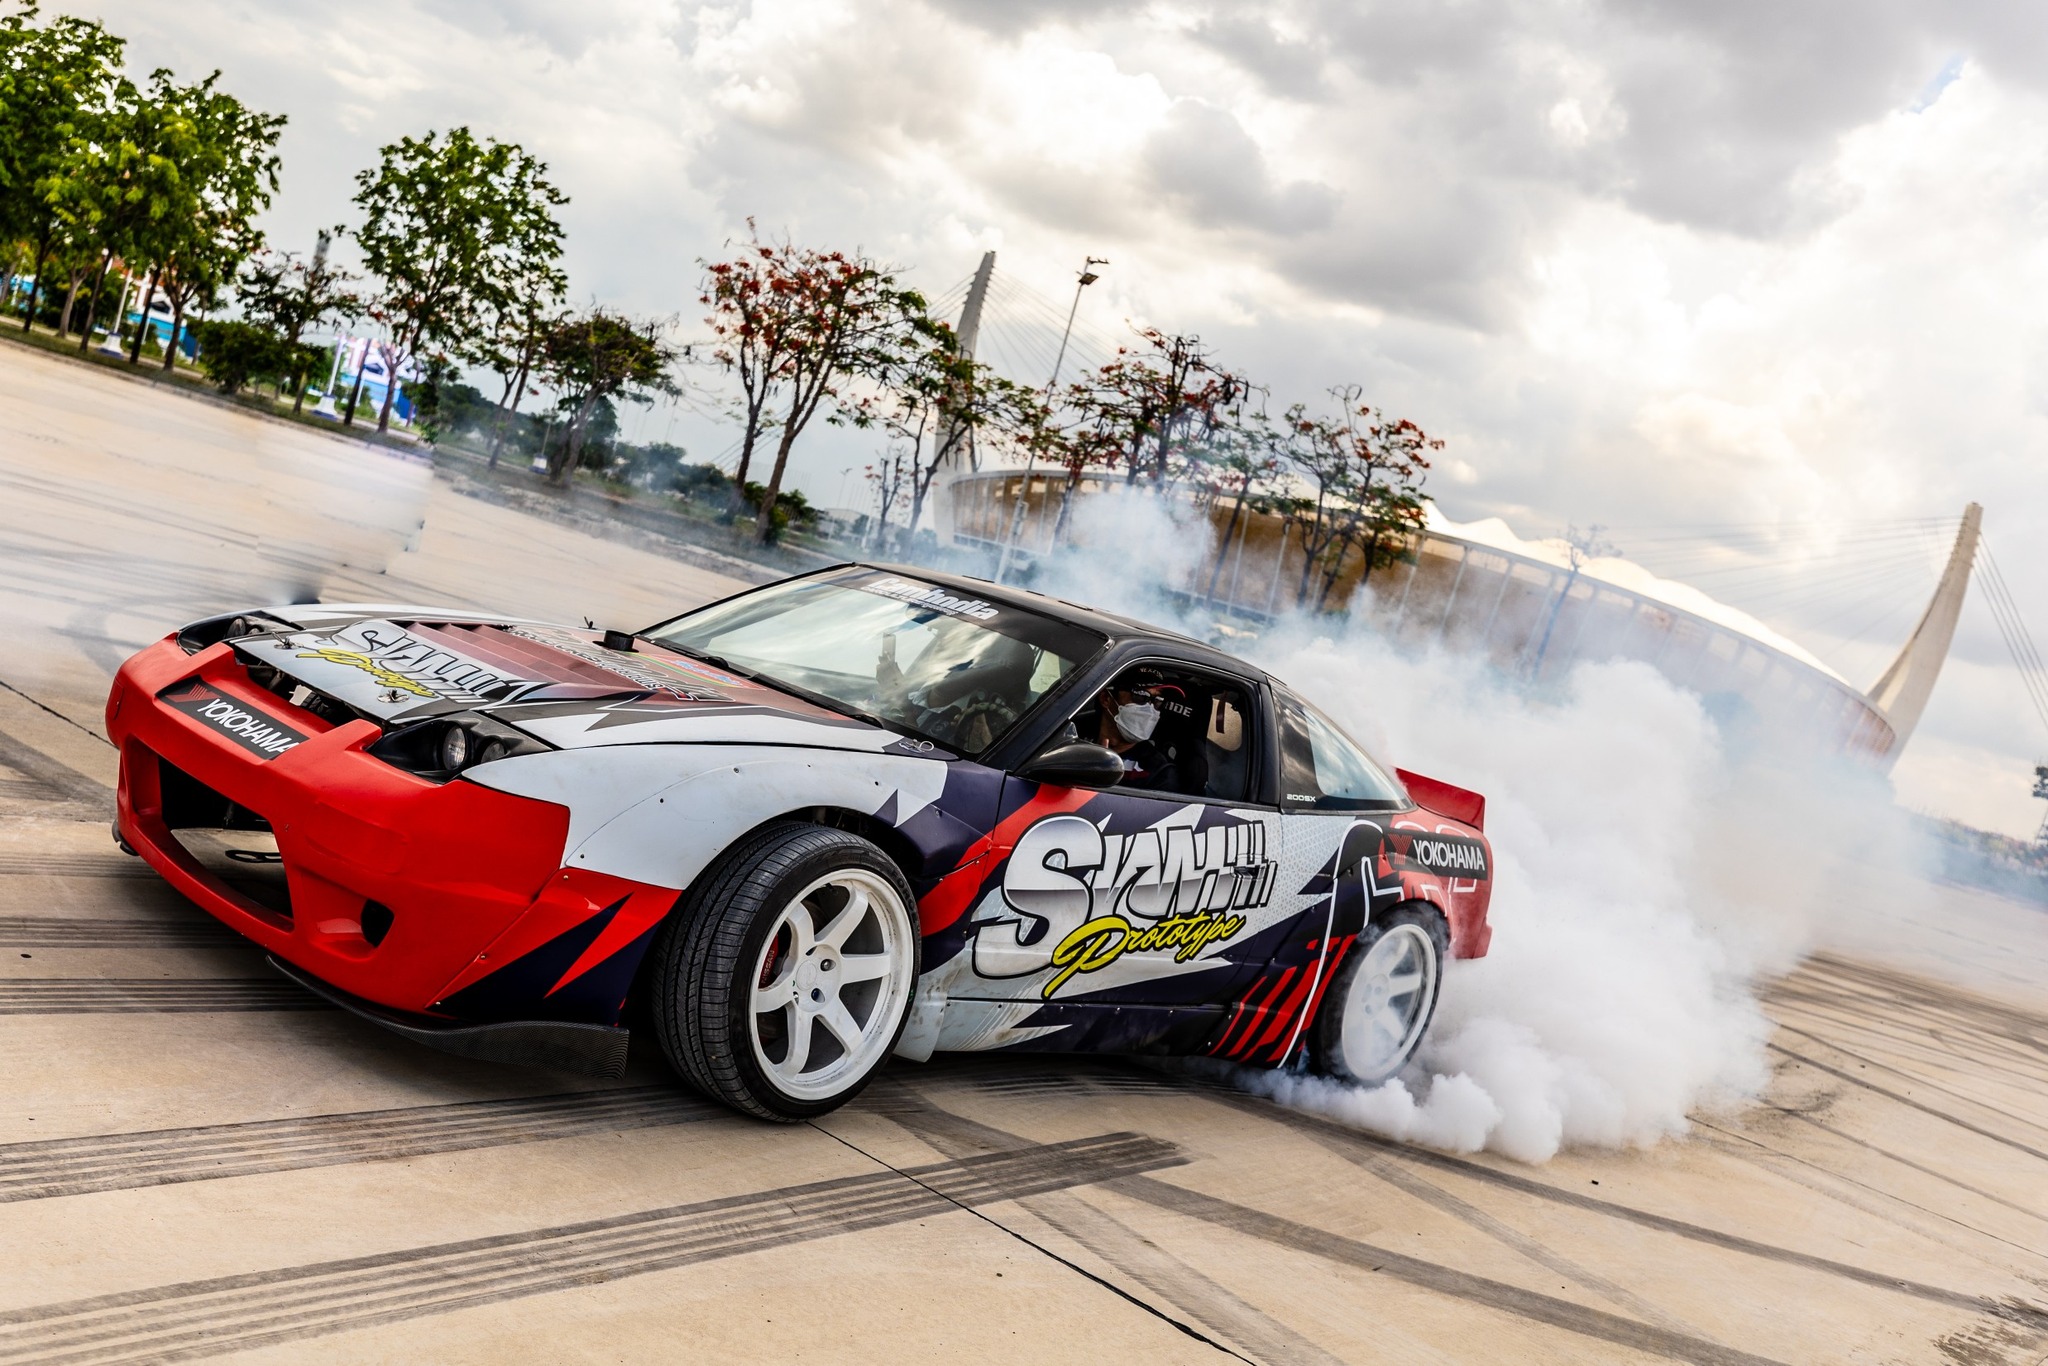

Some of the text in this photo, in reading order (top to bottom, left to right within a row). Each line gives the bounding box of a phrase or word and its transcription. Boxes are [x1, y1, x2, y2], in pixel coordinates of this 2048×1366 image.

[197, 698, 300, 753] YOKOHAMA
[1286, 793, 1317, 803] 200SX
[1413, 838, 1486, 871] YOKOHAMA
[1040, 909, 1247, 1000] Prototype
